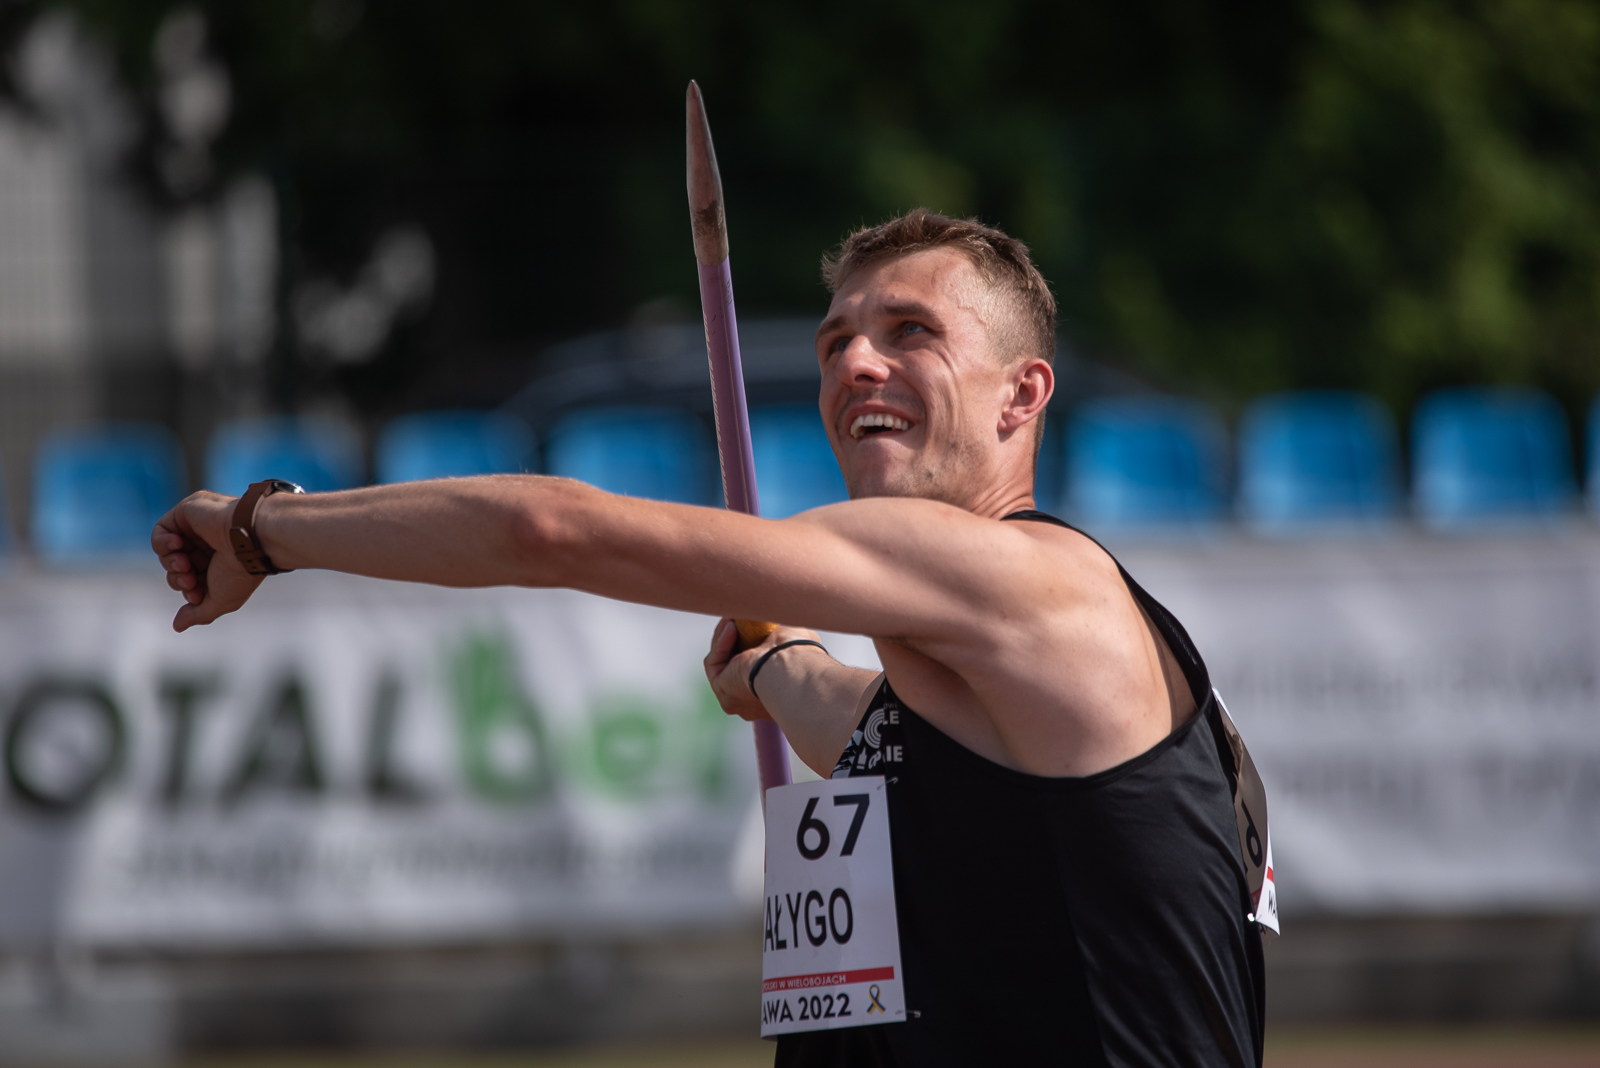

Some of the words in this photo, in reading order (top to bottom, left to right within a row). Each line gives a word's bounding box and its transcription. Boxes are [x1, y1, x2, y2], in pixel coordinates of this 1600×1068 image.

[796, 793, 870, 860] 67
[764, 888, 853, 953] AŁYGO
[779, 980, 786, 990] W
[787, 974, 847, 989] WIELOBOJACH
[762, 998, 794, 1026] AWA
[798, 992, 852, 1021] 2022
